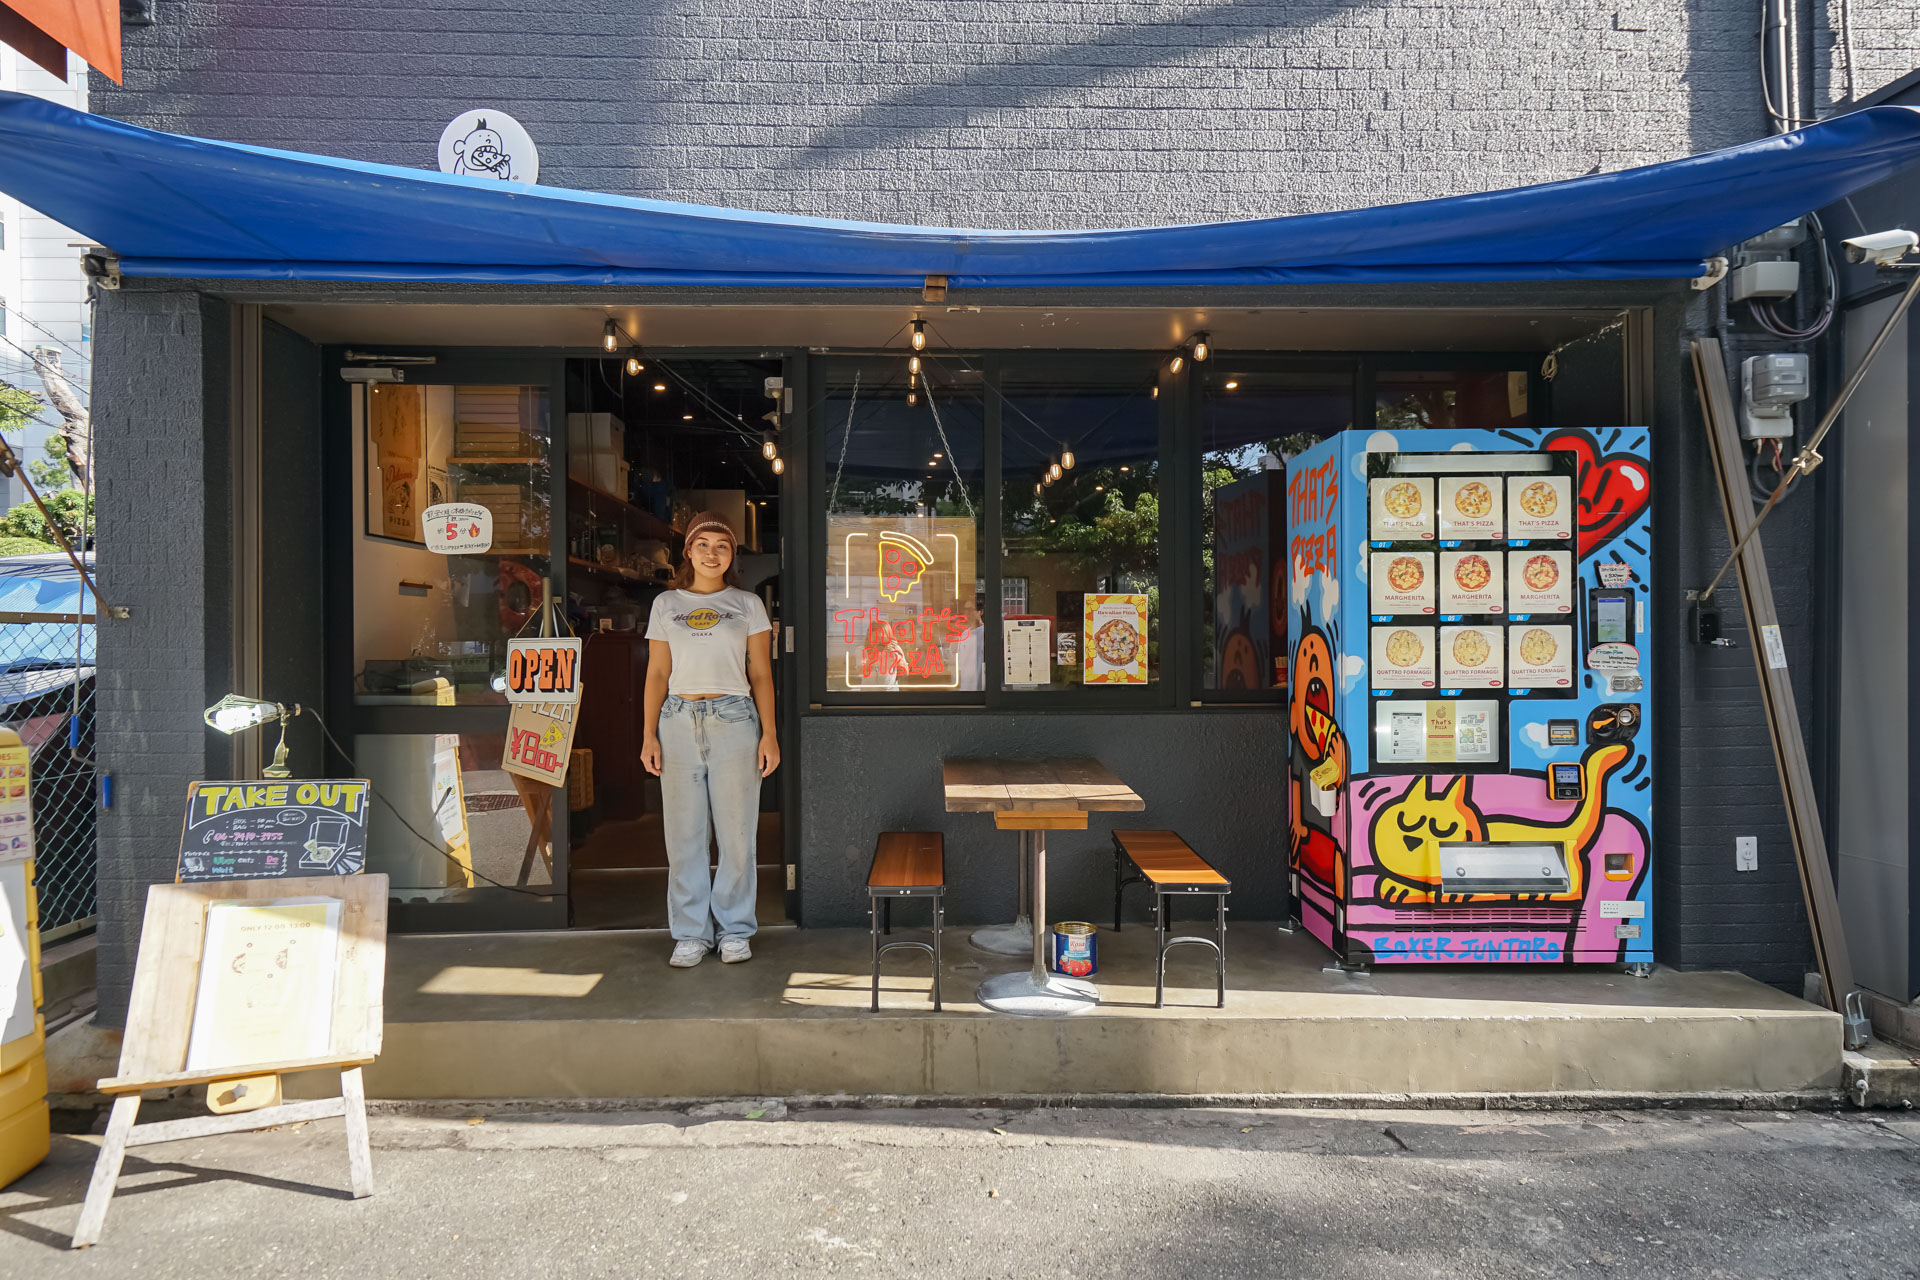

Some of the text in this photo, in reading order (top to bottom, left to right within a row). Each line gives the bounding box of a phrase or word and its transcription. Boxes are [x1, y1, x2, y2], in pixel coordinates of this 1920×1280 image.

[1287, 454, 1338, 529] THAT'S
[1290, 524, 1337, 583] PIZZA
[673, 612, 734, 622] Hard Rock
[834, 607, 970, 645] That's
[509, 648, 577, 693] OPEN
[862, 644, 944, 678] PIZZA
[199, 783, 364, 816] TAKE OUT
[1373, 937, 1560, 962] BOXER JUNTARO
